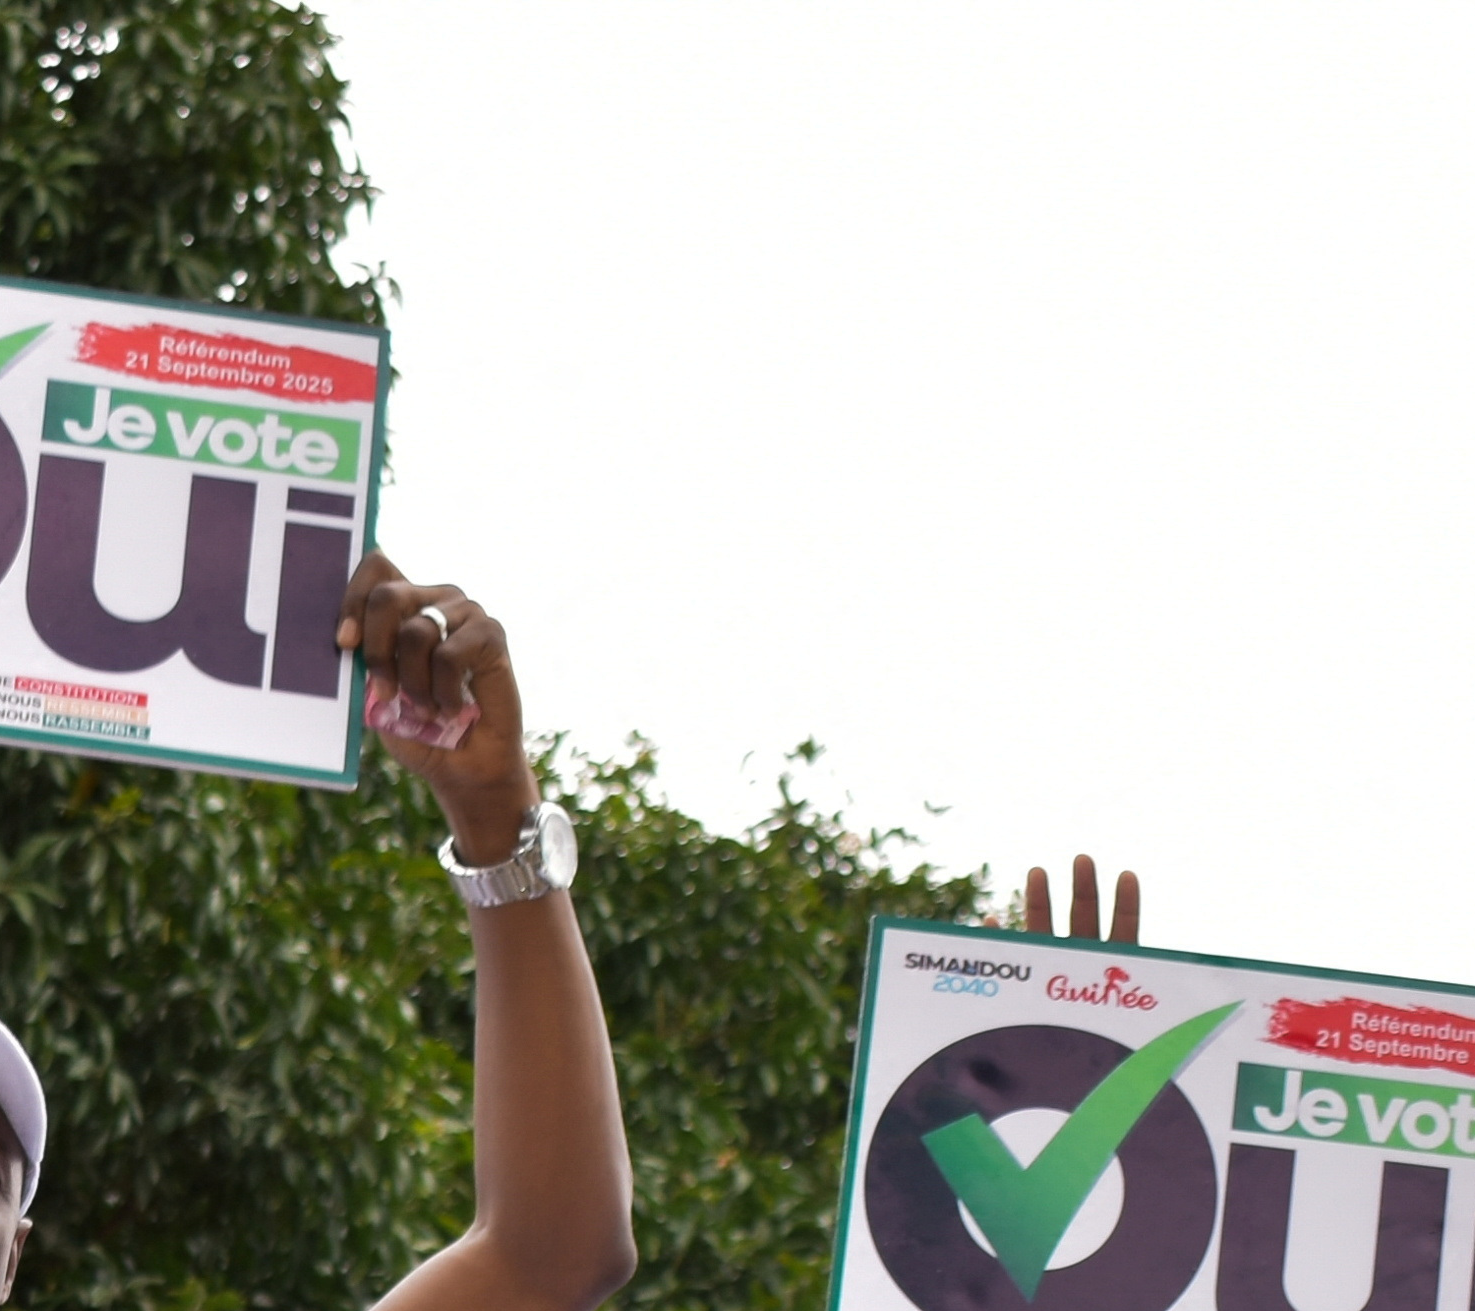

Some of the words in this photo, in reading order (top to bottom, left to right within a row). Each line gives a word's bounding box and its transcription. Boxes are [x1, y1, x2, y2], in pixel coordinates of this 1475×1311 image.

[159, 335, 291, 369] Référendum
[125, 351, 150, 371] 21
[157, 356, 277, 388] Septembre
[282, 371, 334, 396] 2025
[63, 387, 157, 451] Je
[165, 410, 340, 476] vote
[17, 677, 140, 706] CONSTITUTION
[44, 714, 150, 740] RASSEMBLE
[904, 952, 1032, 982] SIMANDOU
[932, 974, 1000, 998] 2040
[1315, 1029, 1341, 1049] 21
[1349, 1032, 1470, 1065] Septembre
[1252, 1069, 1349, 1138] Je
